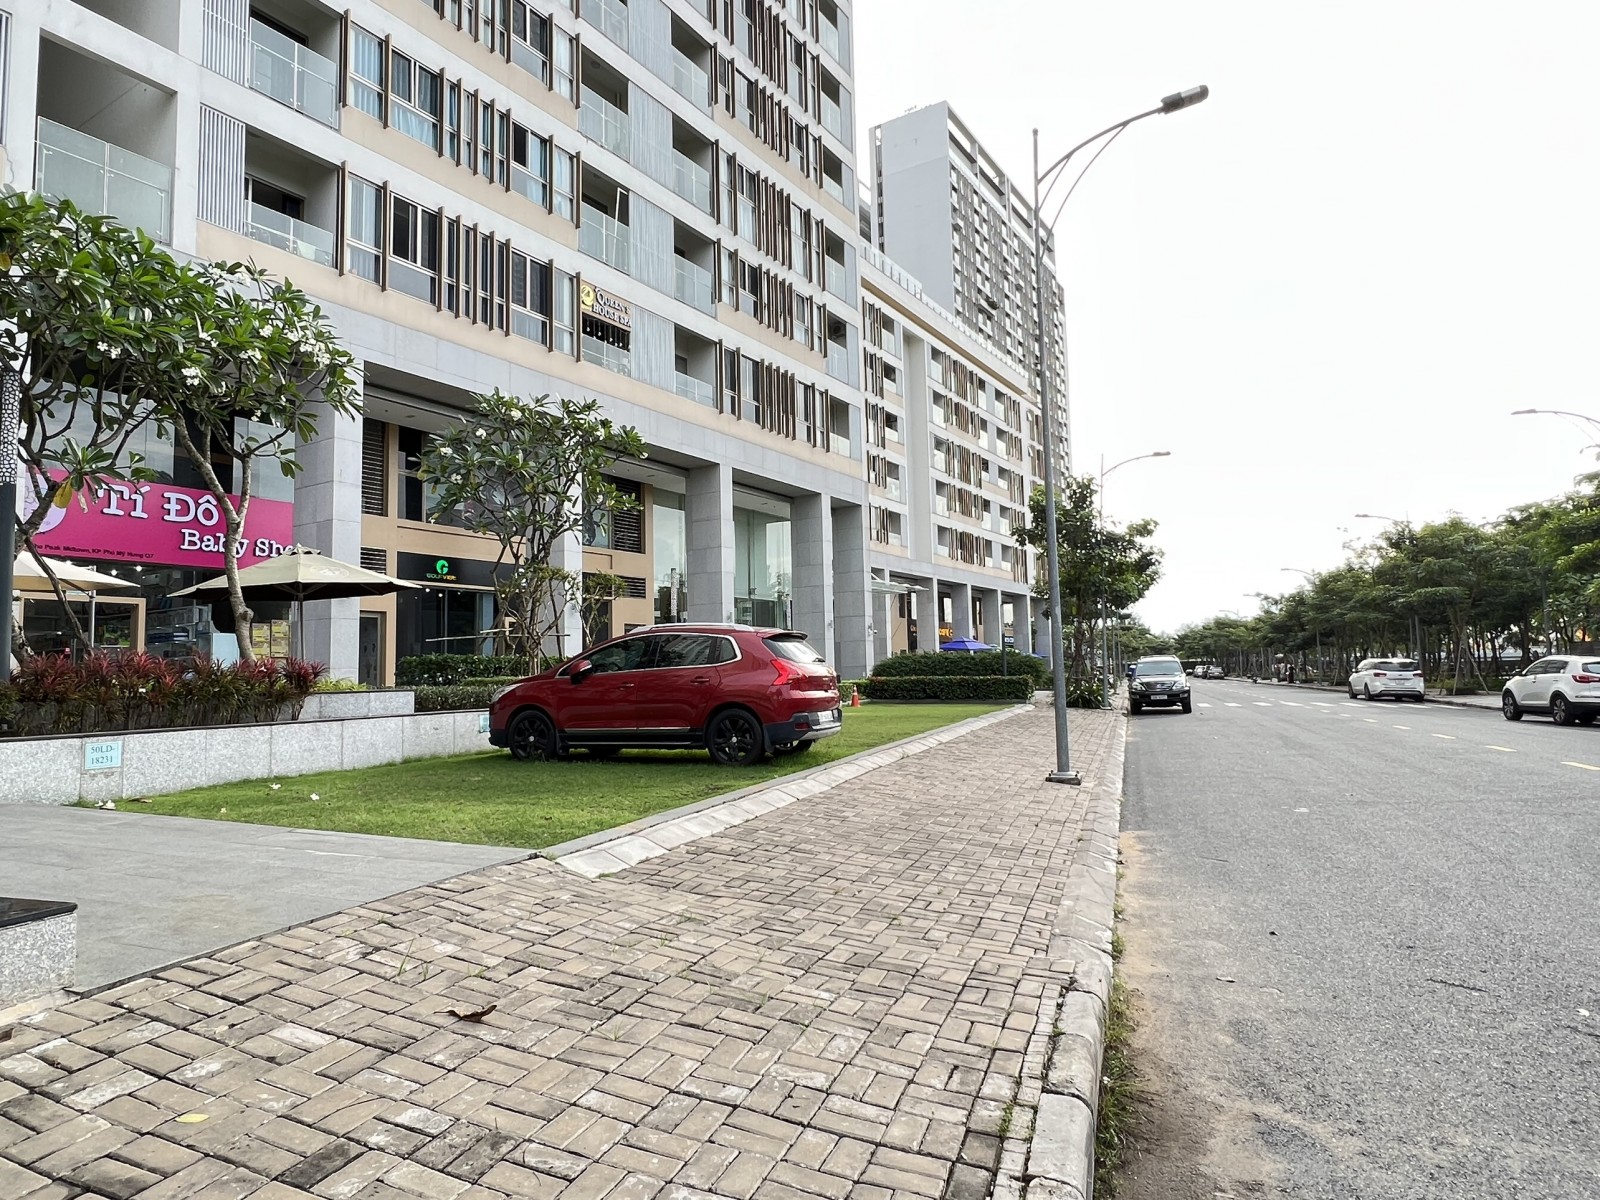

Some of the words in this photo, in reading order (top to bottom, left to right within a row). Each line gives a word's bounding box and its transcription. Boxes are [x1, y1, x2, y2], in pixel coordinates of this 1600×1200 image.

[592, 303, 619, 323] HOUSE
[619, 315, 632, 328] SPA
[97, 482, 151, 519] Tí
[163, 491, 219, 526] Đô
[91, 755, 113, 765] 18231
